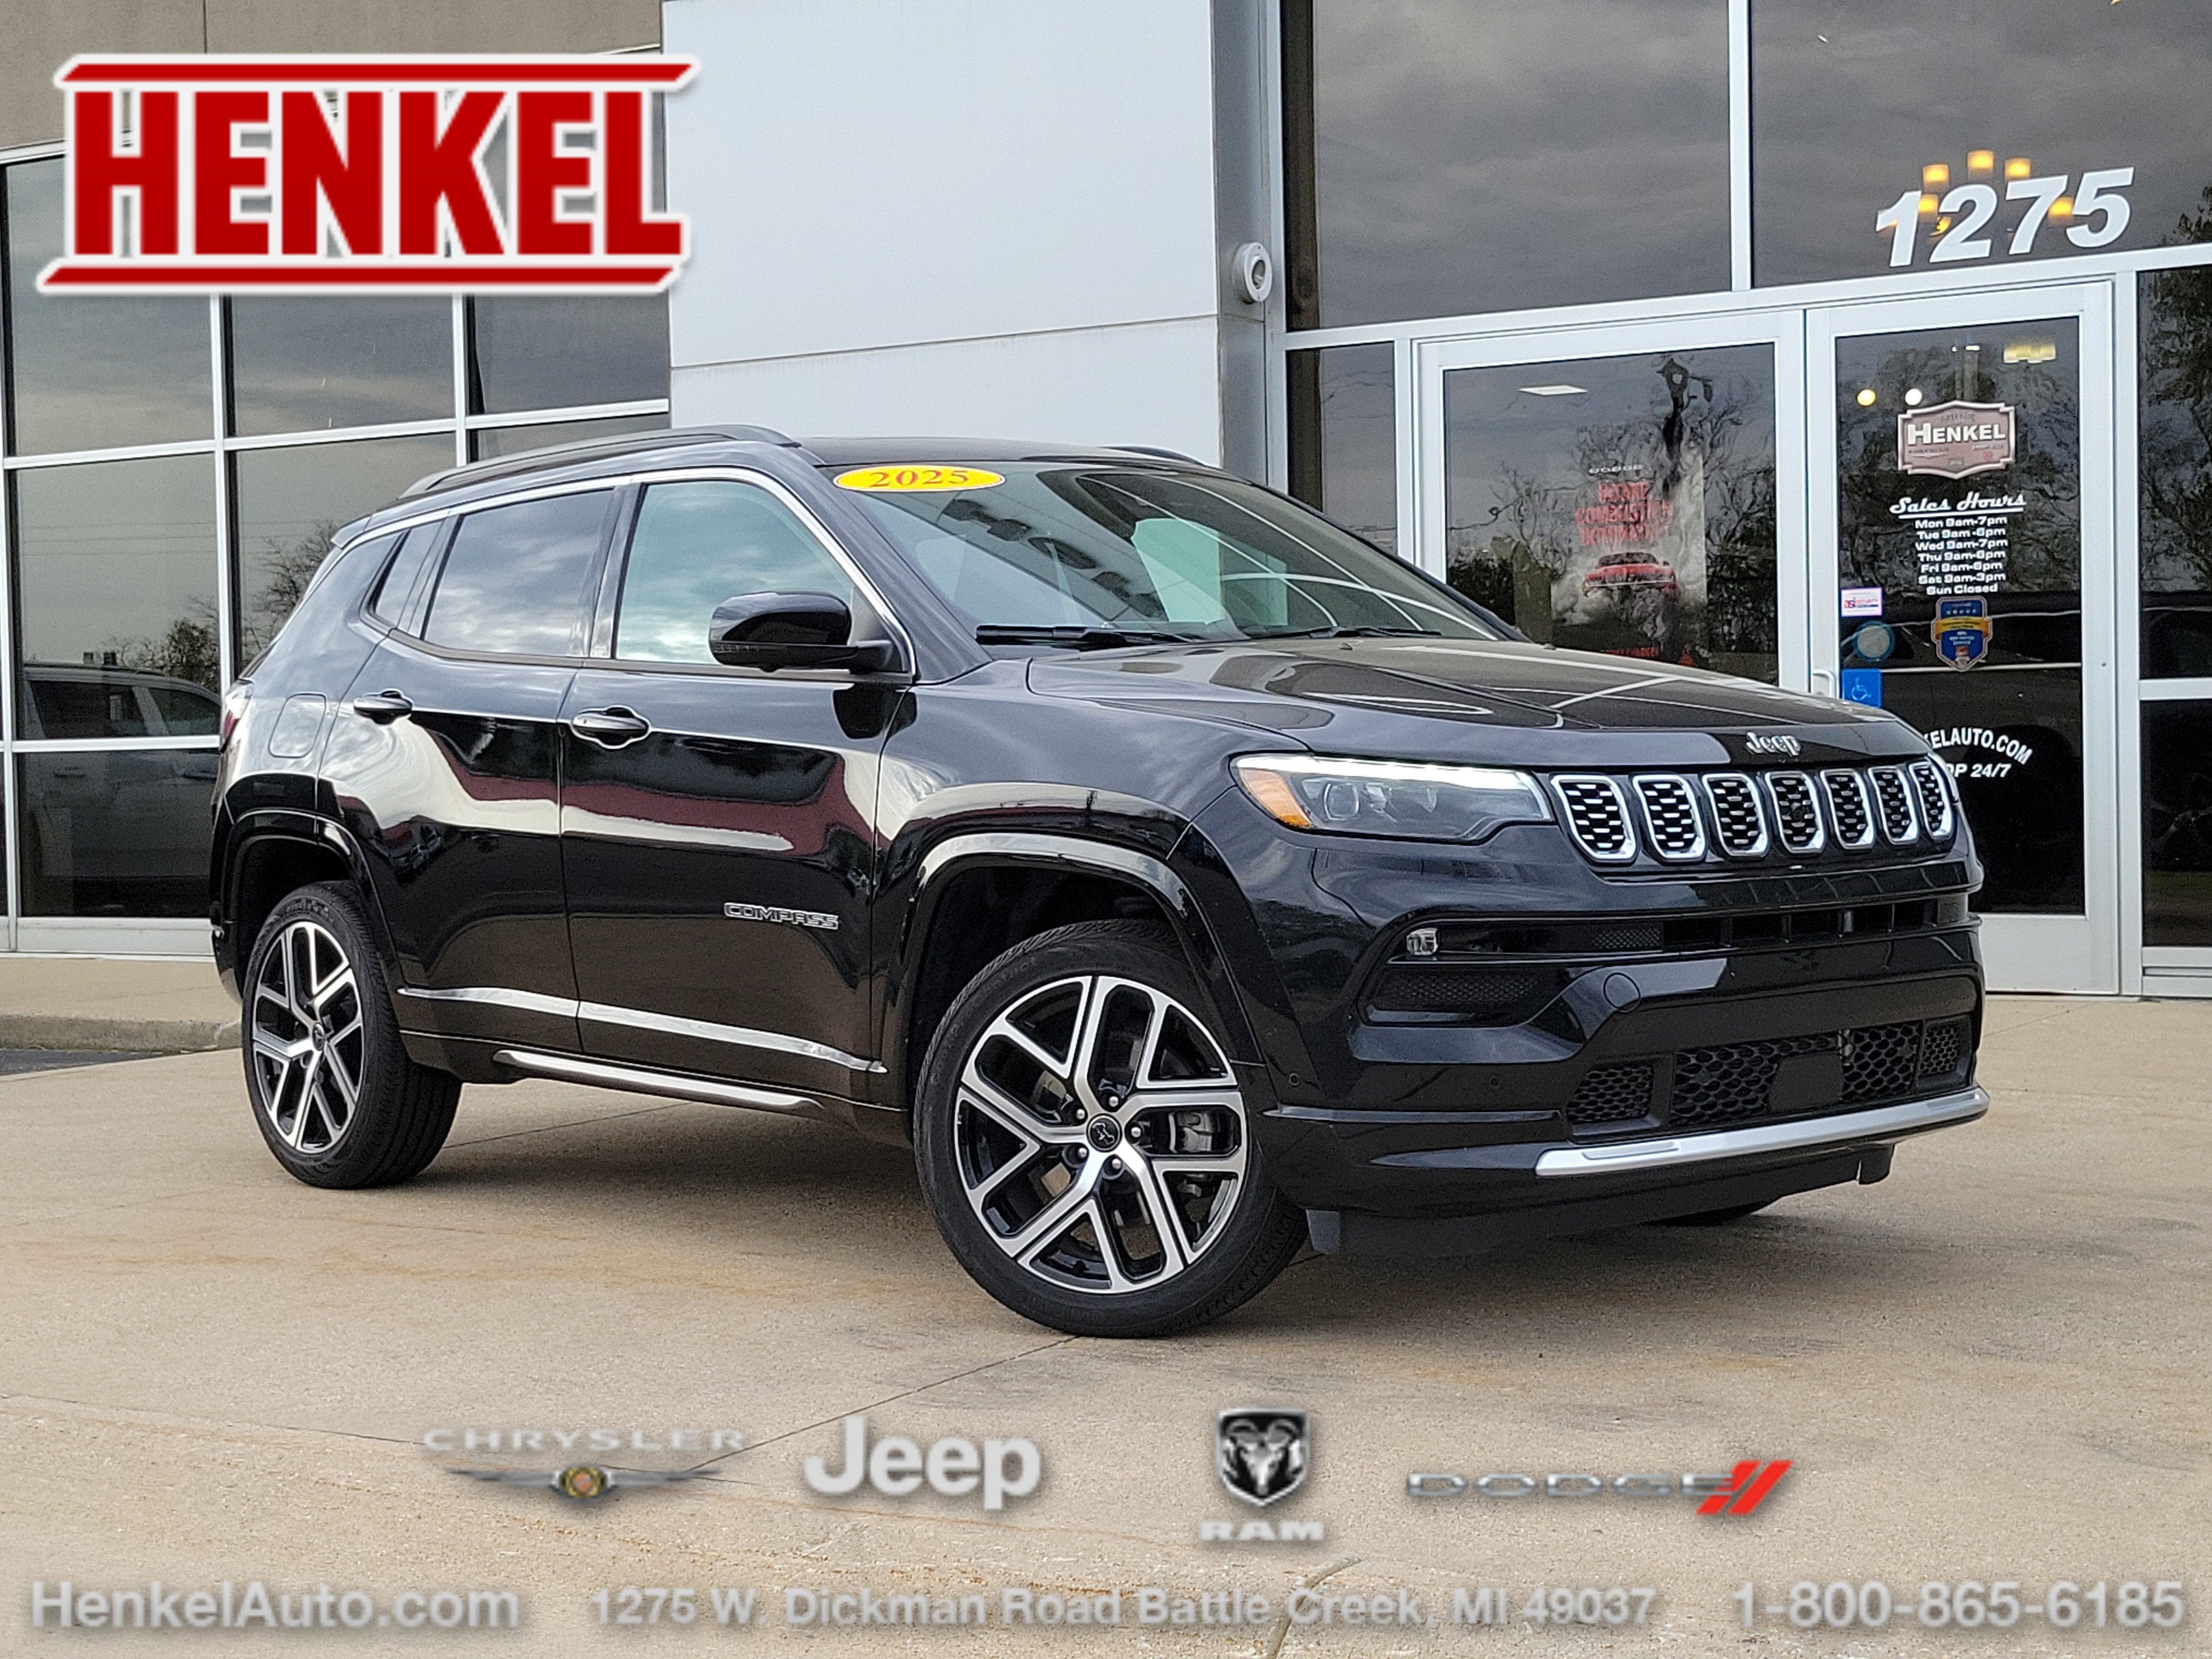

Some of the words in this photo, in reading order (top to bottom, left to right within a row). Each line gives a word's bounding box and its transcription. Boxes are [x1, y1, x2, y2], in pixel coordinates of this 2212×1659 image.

[1875, 166, 2134, 267] 1275
[1907, 423, 2006, 445] HENKEL
[870, 470, 969, 488] 2025
[1889, 496, 1951, 514] Sales
[1956, 491, 2027, 511] Hours
[1915, 520, 1944, 528] Mon
[1916, 531, 1939, 539] Tue
[1915, 541, 1944, 550] Wed
[1946, 539, 2008, 549] 9am-7pm
[1917, 552, 1942, 562] Thu
[1921, 563, 1939, 573] Fri
[1918, 575, 1942, 584] Sat
[1926, 585, 1952, 595] Sun
[1954, 583, 1998, 594] Closed
[1746, 732, 1801, 757] Jeep
[1970, 763, 2012, 778] 24/7
[724, 902, 839, 930] COMPASS
